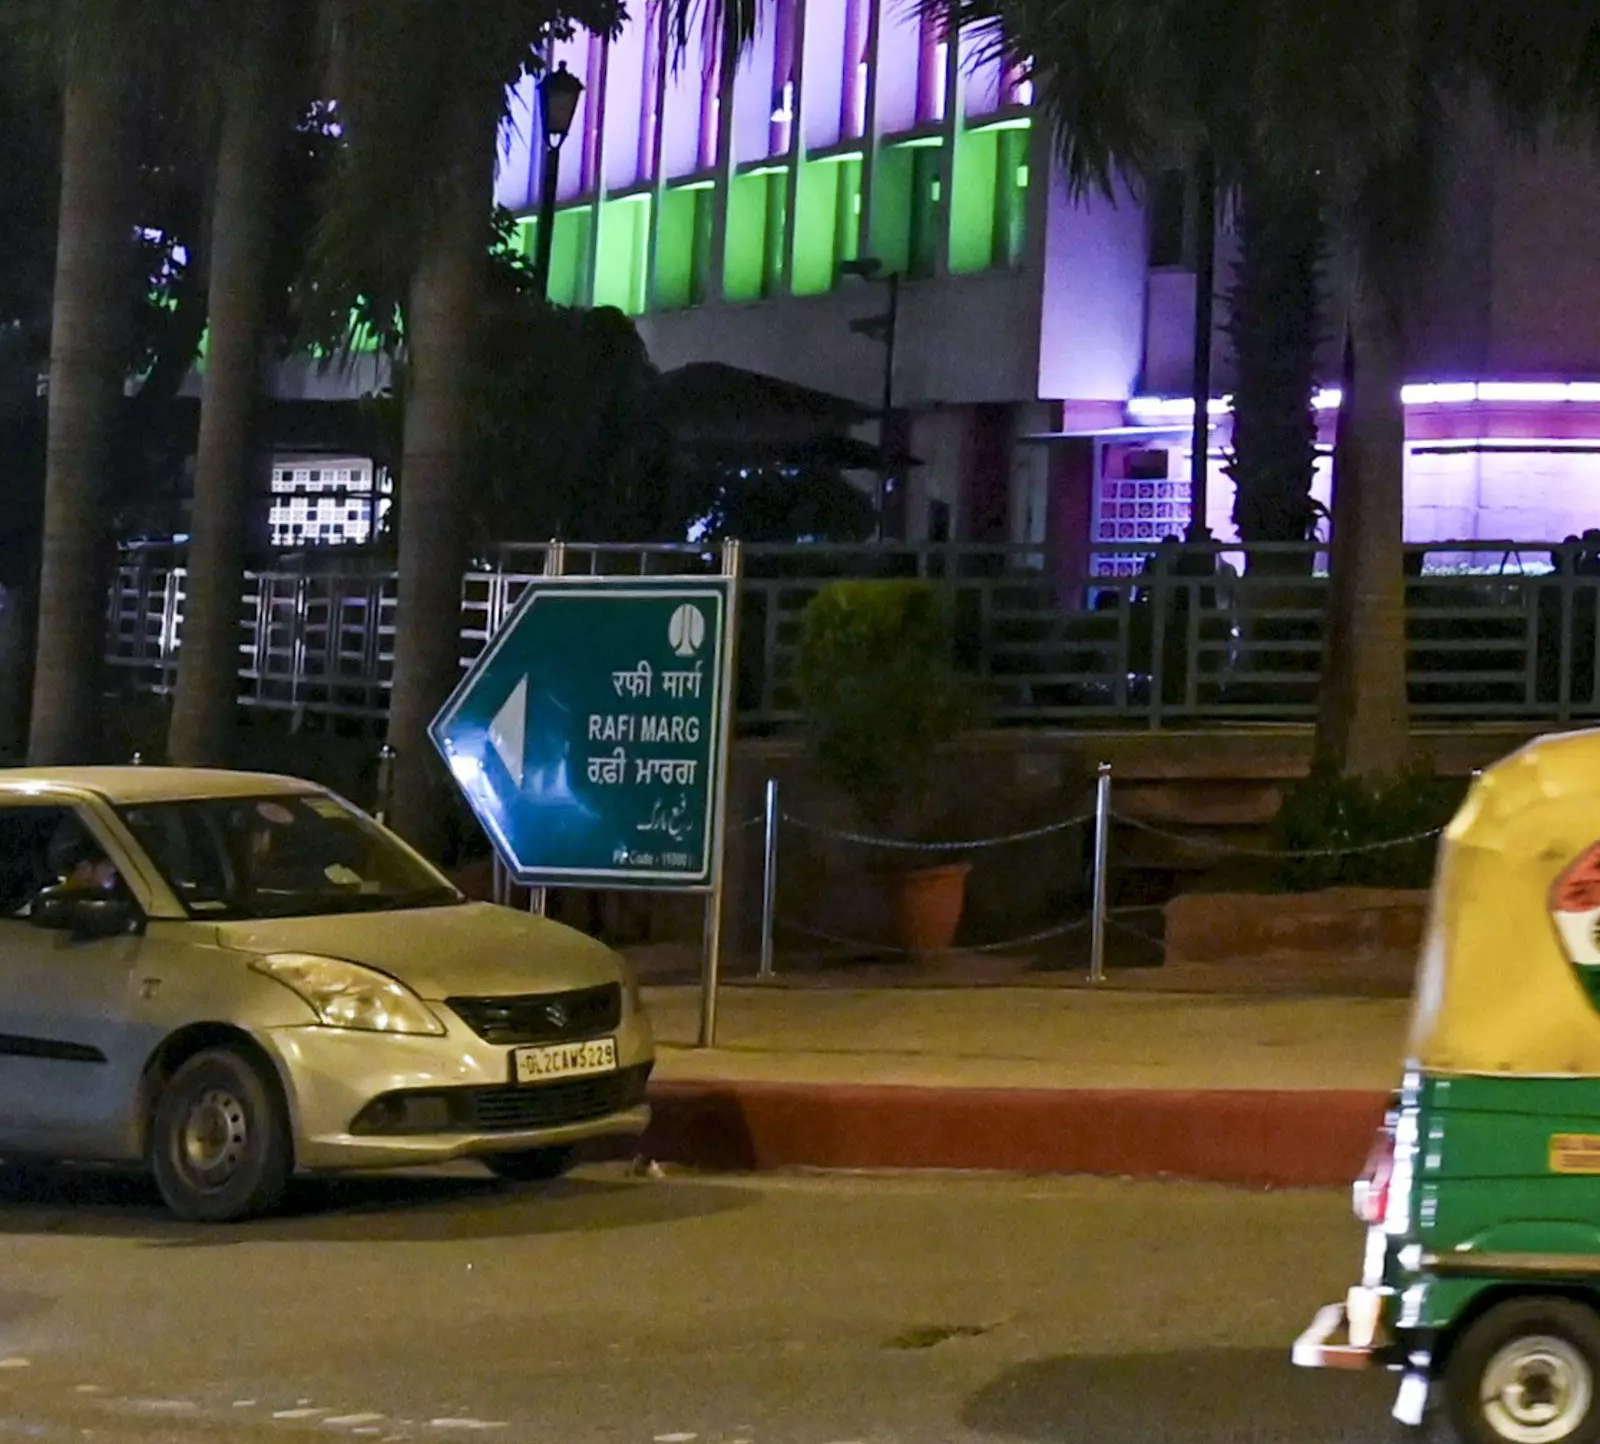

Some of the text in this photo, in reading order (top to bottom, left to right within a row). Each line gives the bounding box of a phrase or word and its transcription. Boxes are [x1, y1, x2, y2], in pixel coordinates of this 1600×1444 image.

[612, 659, 703, 698] रफी मार्ग
[588, 714, 700, 743] RAFI MARG
[635, 758, 697, 785] ਮਾਰਗ
